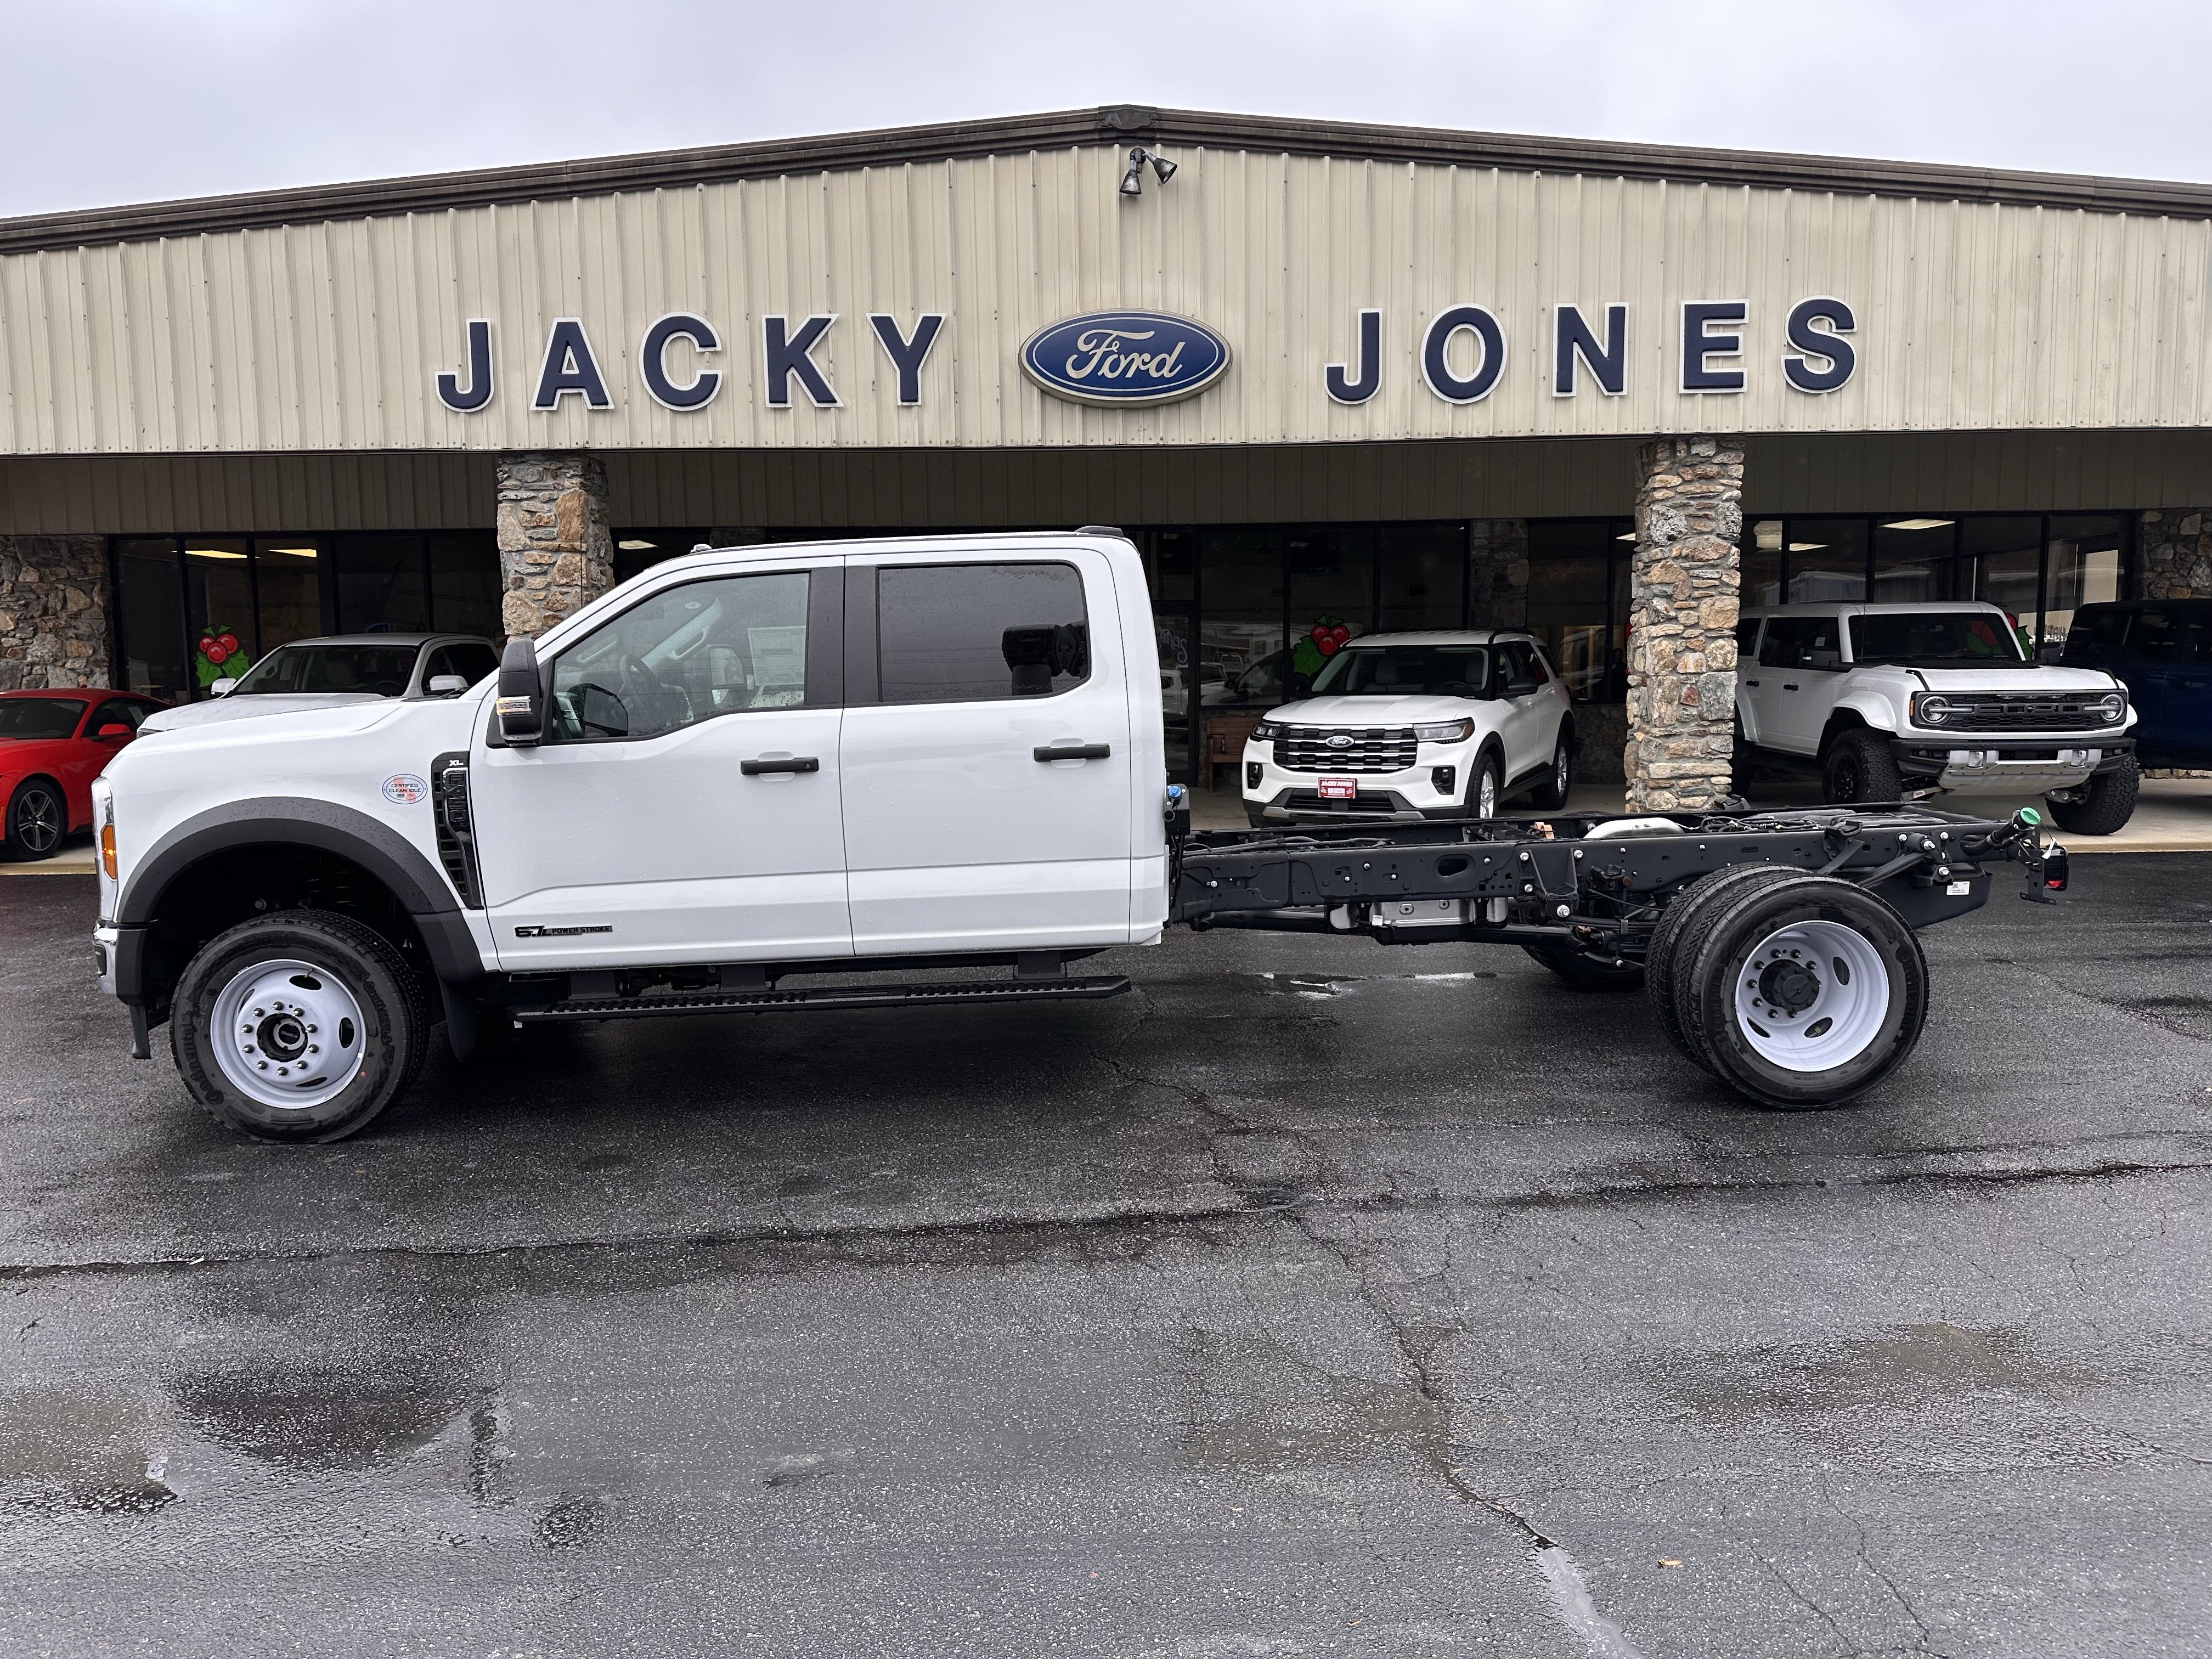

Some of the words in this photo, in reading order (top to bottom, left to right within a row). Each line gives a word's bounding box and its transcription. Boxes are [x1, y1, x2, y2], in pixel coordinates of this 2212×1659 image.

[436, 311, 947, 413] JACKY
[1323, 295, 1857, 404] JONES
[1066, 329, 1186, 380] Ford
[1975, 703, 2084, 716] FORD
